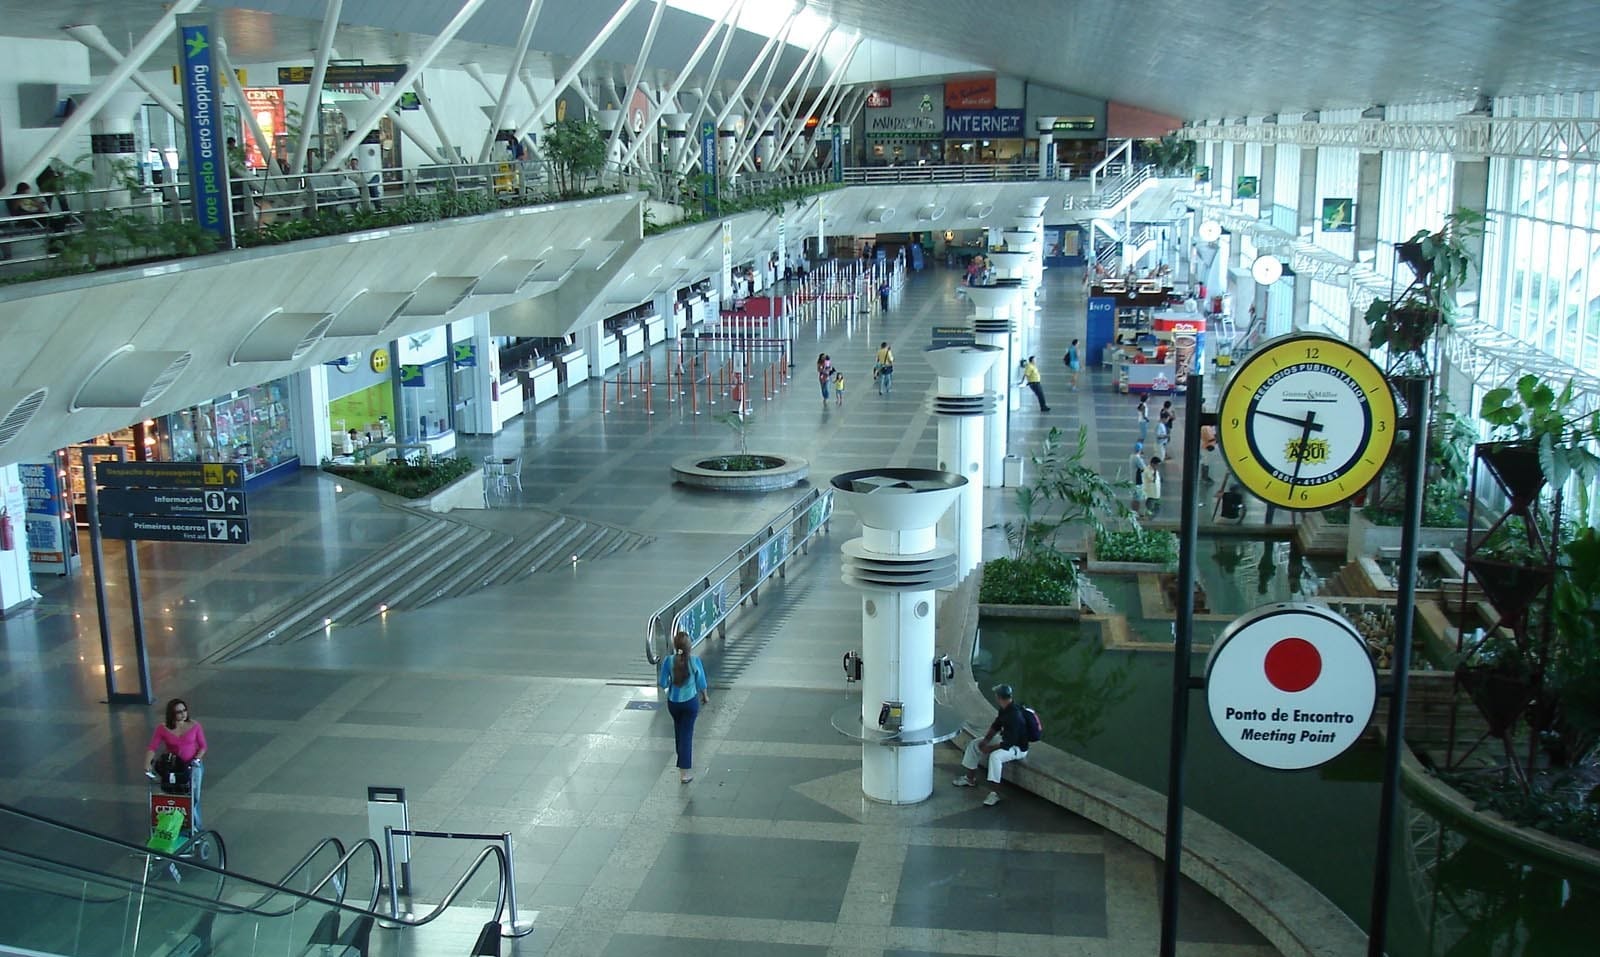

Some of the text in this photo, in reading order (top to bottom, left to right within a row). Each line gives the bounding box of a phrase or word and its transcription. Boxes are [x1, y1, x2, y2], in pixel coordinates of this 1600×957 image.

[946, 115, 1020, 132] INTERNET
[192, 64, 219, 225] voe pelo aero shopping
[1305, 347, 1319, 359] 12
[1231, 417, 1239, 429] 9
[1377, 420, 1386, 432] 3
[1289, 448, 1325, 461] AQUI
[154, 496, 203, 505] Informações
[1300, 490, 1308, 501] 6
[134, 522, 206, 532] Primeiros socorros
[1226, 707, 1354, 724] Ponto de Encontro
[1241, 728, 1336, 744] Meeting Point
